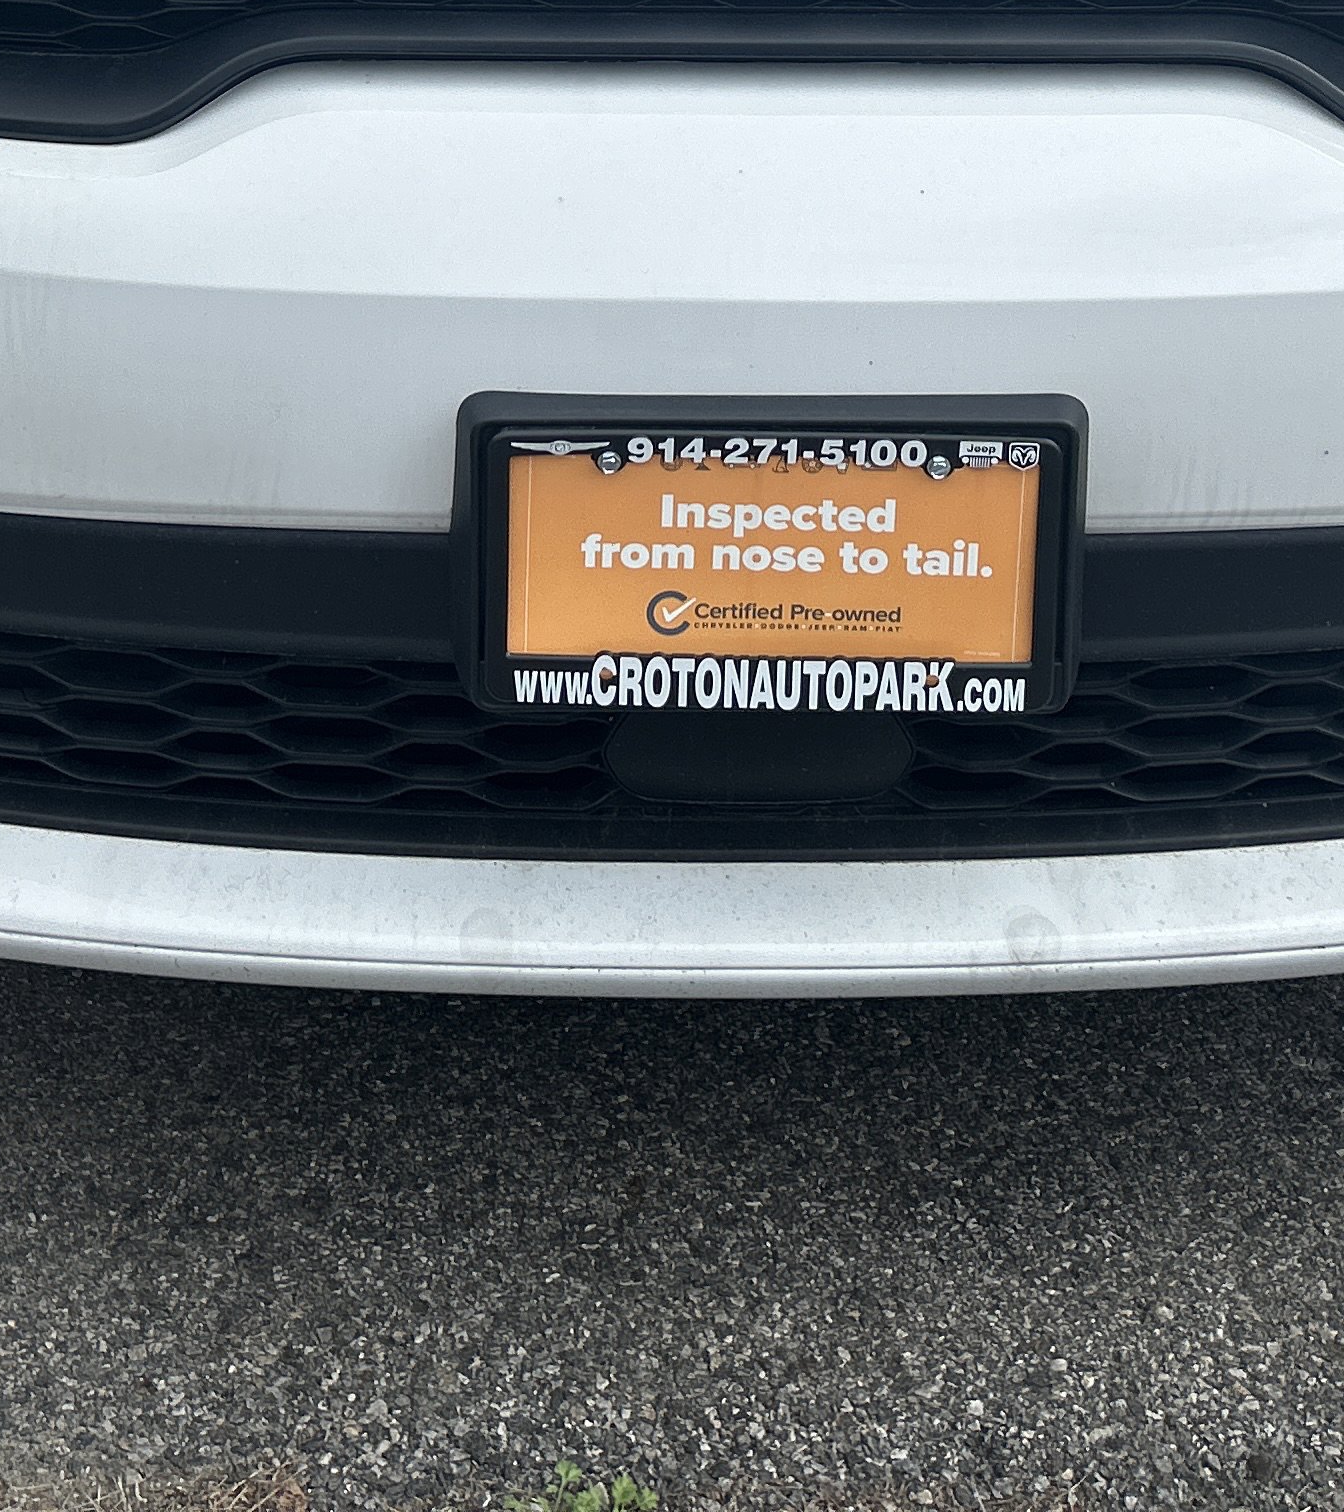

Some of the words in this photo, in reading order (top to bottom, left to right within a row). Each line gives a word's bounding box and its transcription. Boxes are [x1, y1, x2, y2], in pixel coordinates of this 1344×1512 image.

[626, 436, 928, 469] 914-271-5100
[966, 444, 997, 455] Jeep
[660, 493, 898, 538] Inspected
[580, 533, 697, 571] from
[712, 543, 826, 574] nose
[839, 541, 889, 575] to
[902, 538, 994, 578] tail.
[693, 601, 783, 621] Certified
[790, 603, 902, 623] Pre-owned
